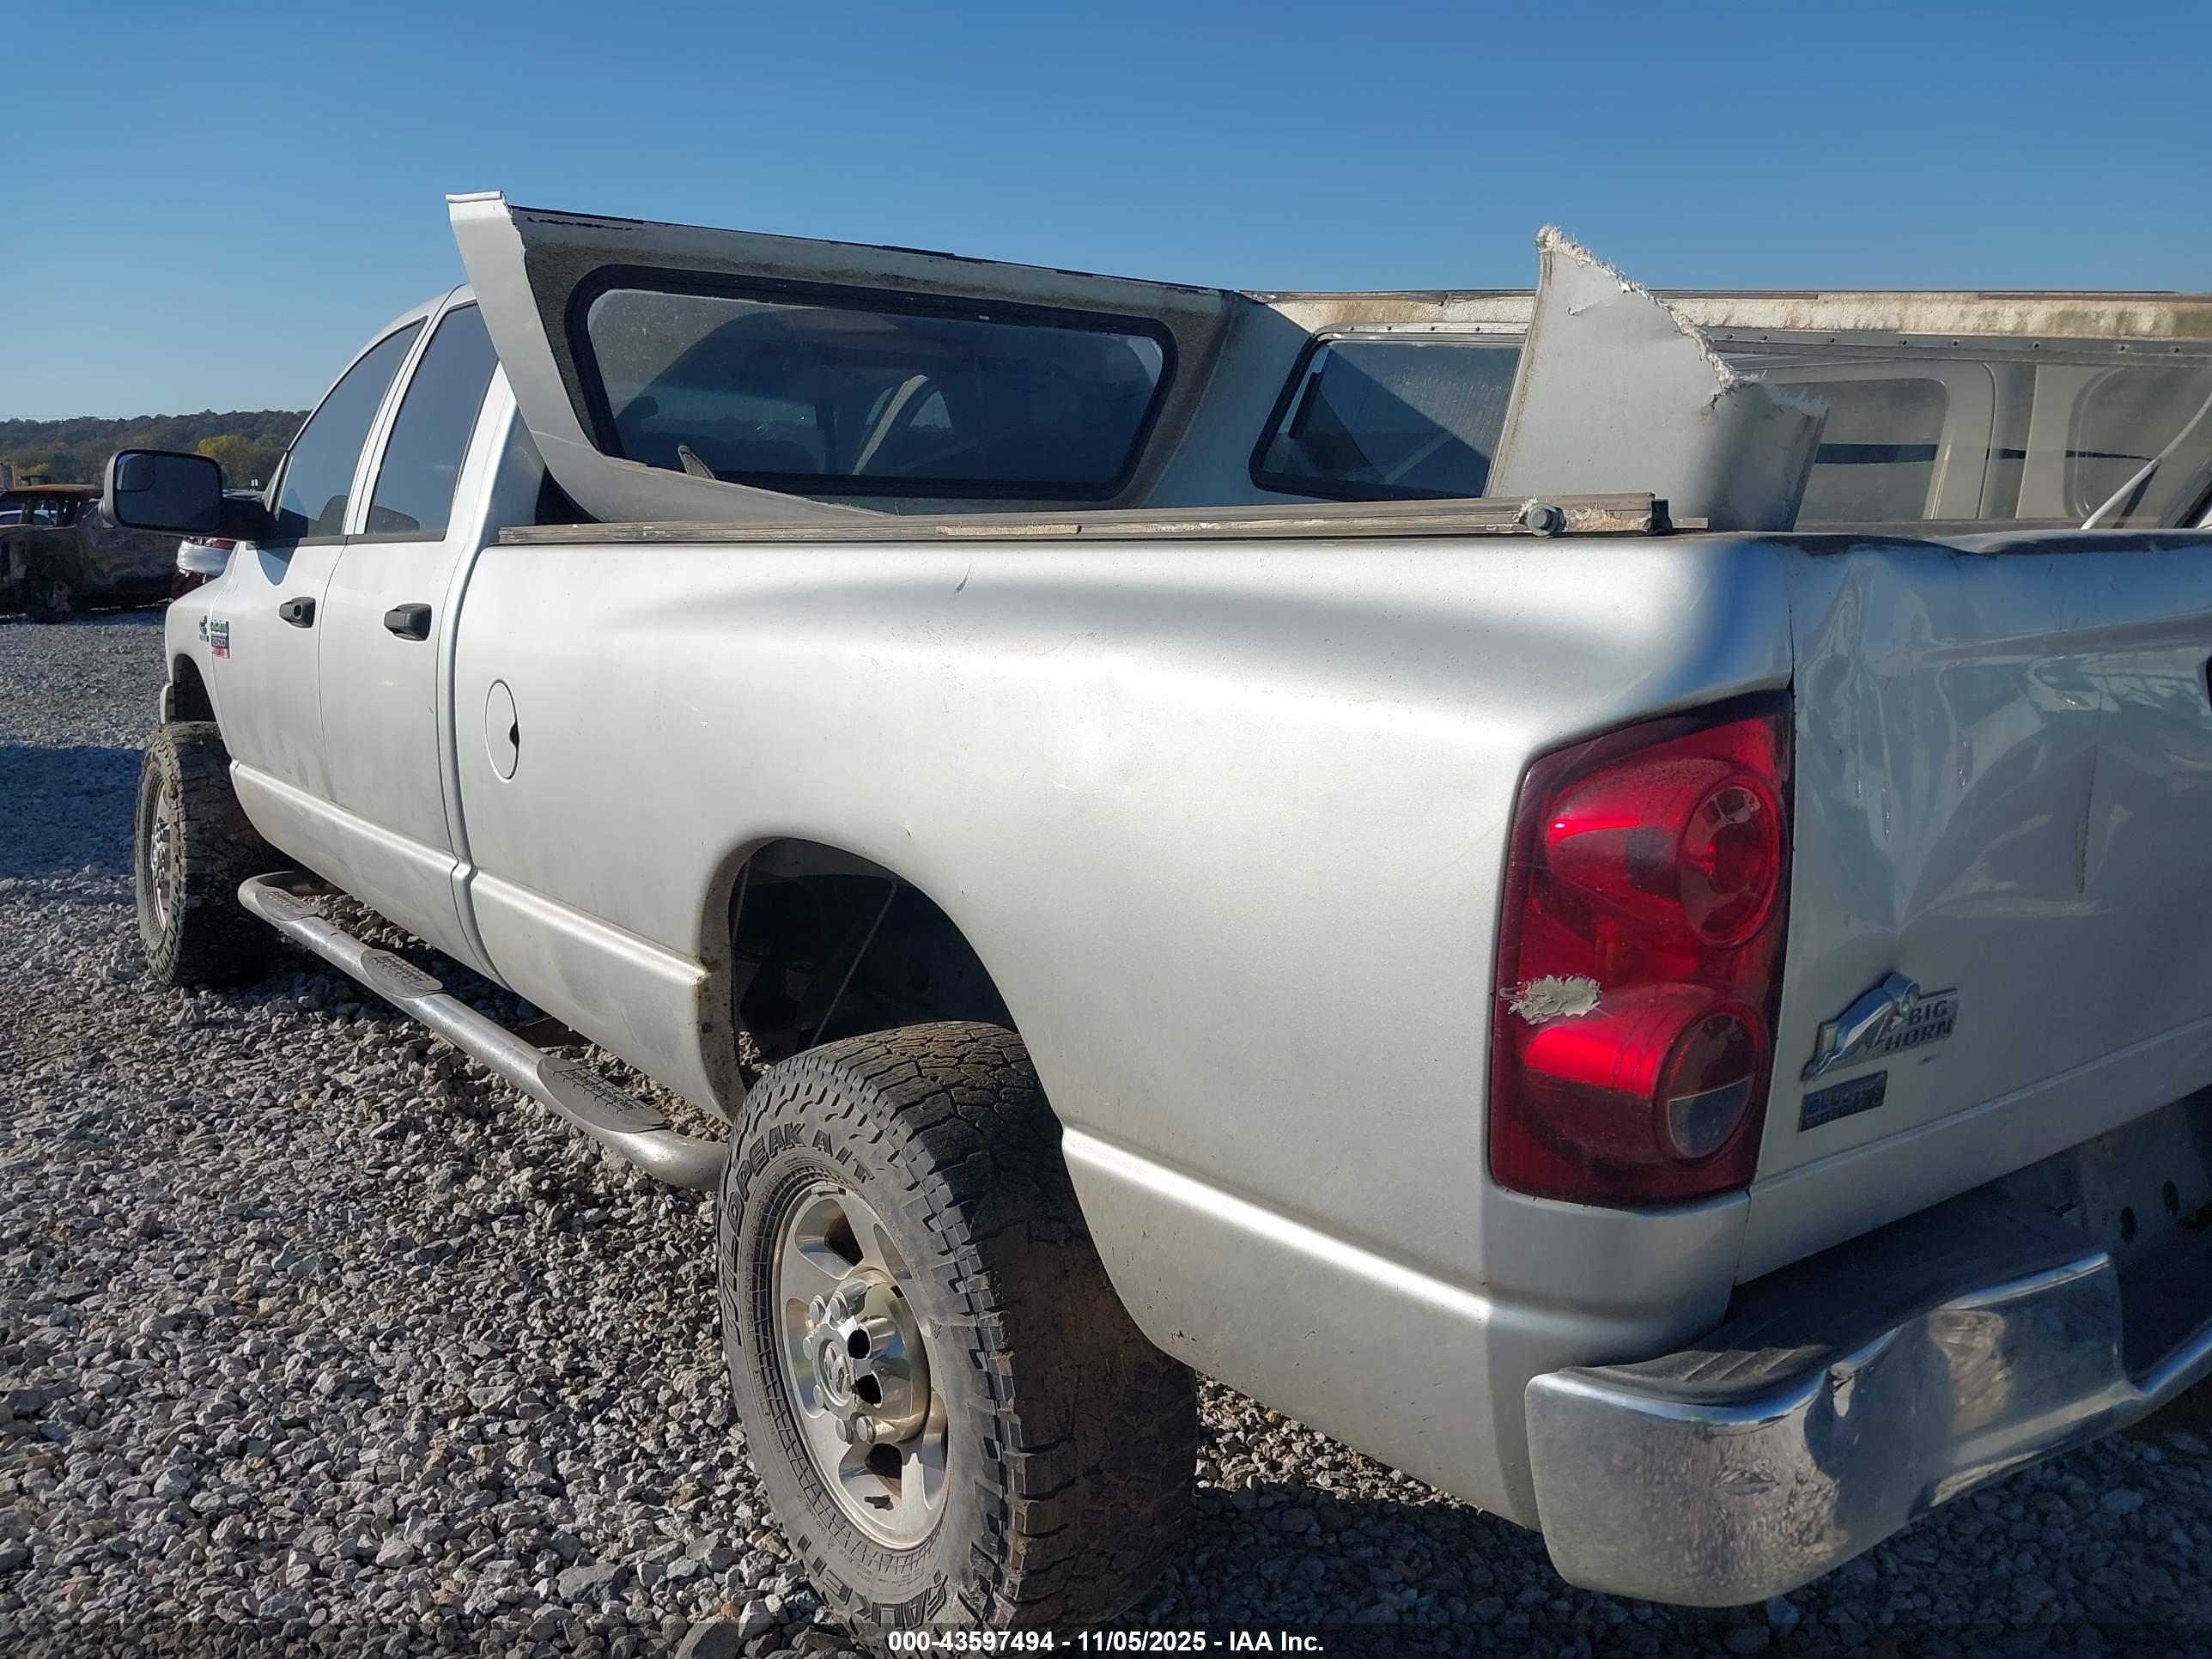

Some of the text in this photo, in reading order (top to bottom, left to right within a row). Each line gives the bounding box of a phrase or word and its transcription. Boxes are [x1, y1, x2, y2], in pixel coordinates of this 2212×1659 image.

[1910, 1000, 1948, 1025] BIG
[1886, 1021, 1953, 1051] HORN
[720, 1121, 806, 1348] WILDPEAK
